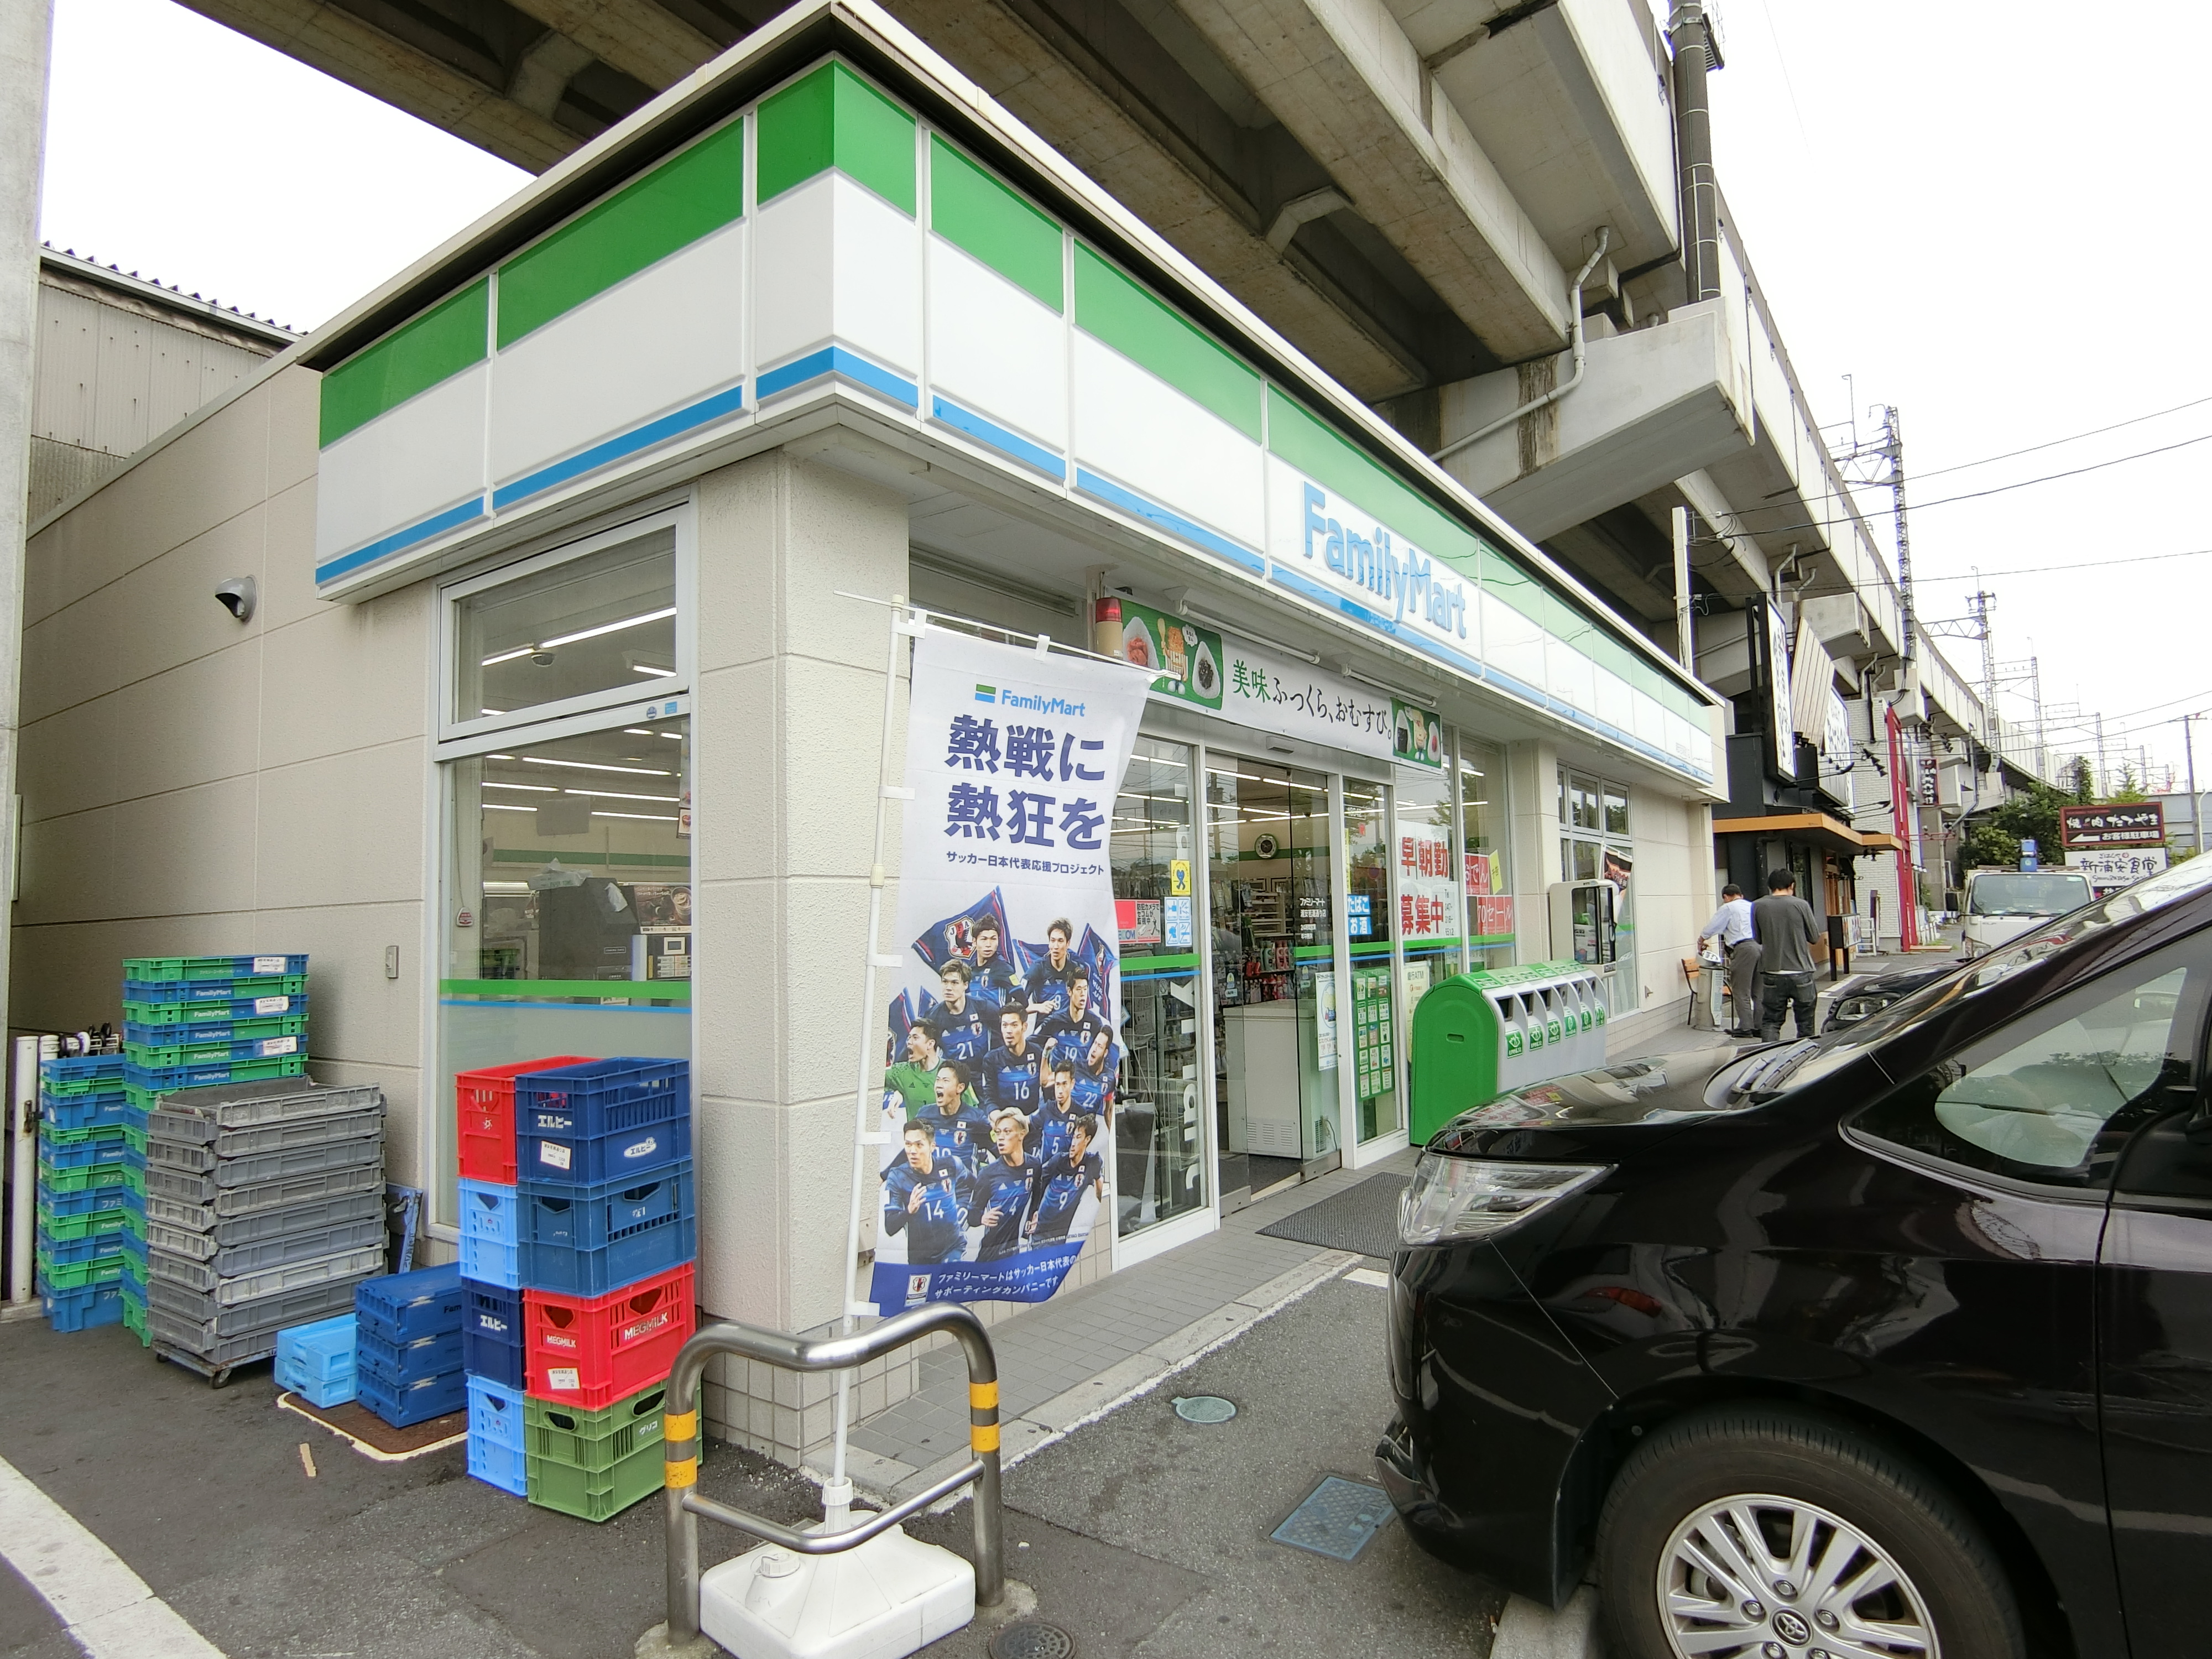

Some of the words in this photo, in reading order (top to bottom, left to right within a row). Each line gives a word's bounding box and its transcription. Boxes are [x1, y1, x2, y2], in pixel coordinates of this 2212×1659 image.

[1302, 481, 1467, 640] FamilyMart
[1001, 690, 1086, 717] FamilyMart
[945, 714, 1105, 781] 熱戦に
[944, 782, 1105, 850] 熱狂を
[2106, 813, 2158, 827] たてやま
[946, 851, 1104, 875] サッカー日本代表応援プロジェクト
[1401, 837, 1448, 878] 早朝勤
[2080, 857, 2157, 876] 新浦安食堂
[1300, 898, 1326, 907] ファミリーマート
[1348, 896, 1370, 914] たばこ
[1400, 894, 1444, 935] 募集中
[1350, 917, 1368, 935] お酒
[194, 1009, 230, 1018] FamilyMart
[195, 1030, 231, 1039] FamilyMart
[194, 1051, 229, 1060] FamilyMart
[957, 1040, 974, 1060] 21
[1064, 1046, 1078, 1062] 19
[194, 1072, 230, 1081] FamilyMart
[1014, 1081, 1030, 1100] 16
[1083, 1092, 1098, 1108] 22
[1051, 1136, 1060, 1155] 5
[925, 1199, 944, 1221] 14
[1009, 1197, 1019, 1215] 4
[1059, 1192, 1068, 1211] 9
[939, 1254, 1077, 1284] ファミリーマートはサッカー日本代表の
[444, 1303, 461, 1314] Fam
[624, 1311, 669, 1340] MEGMILK
[547, 1334, 576, 1348] MEGMILK
[639, 1420, 659, 1436] グリコ
